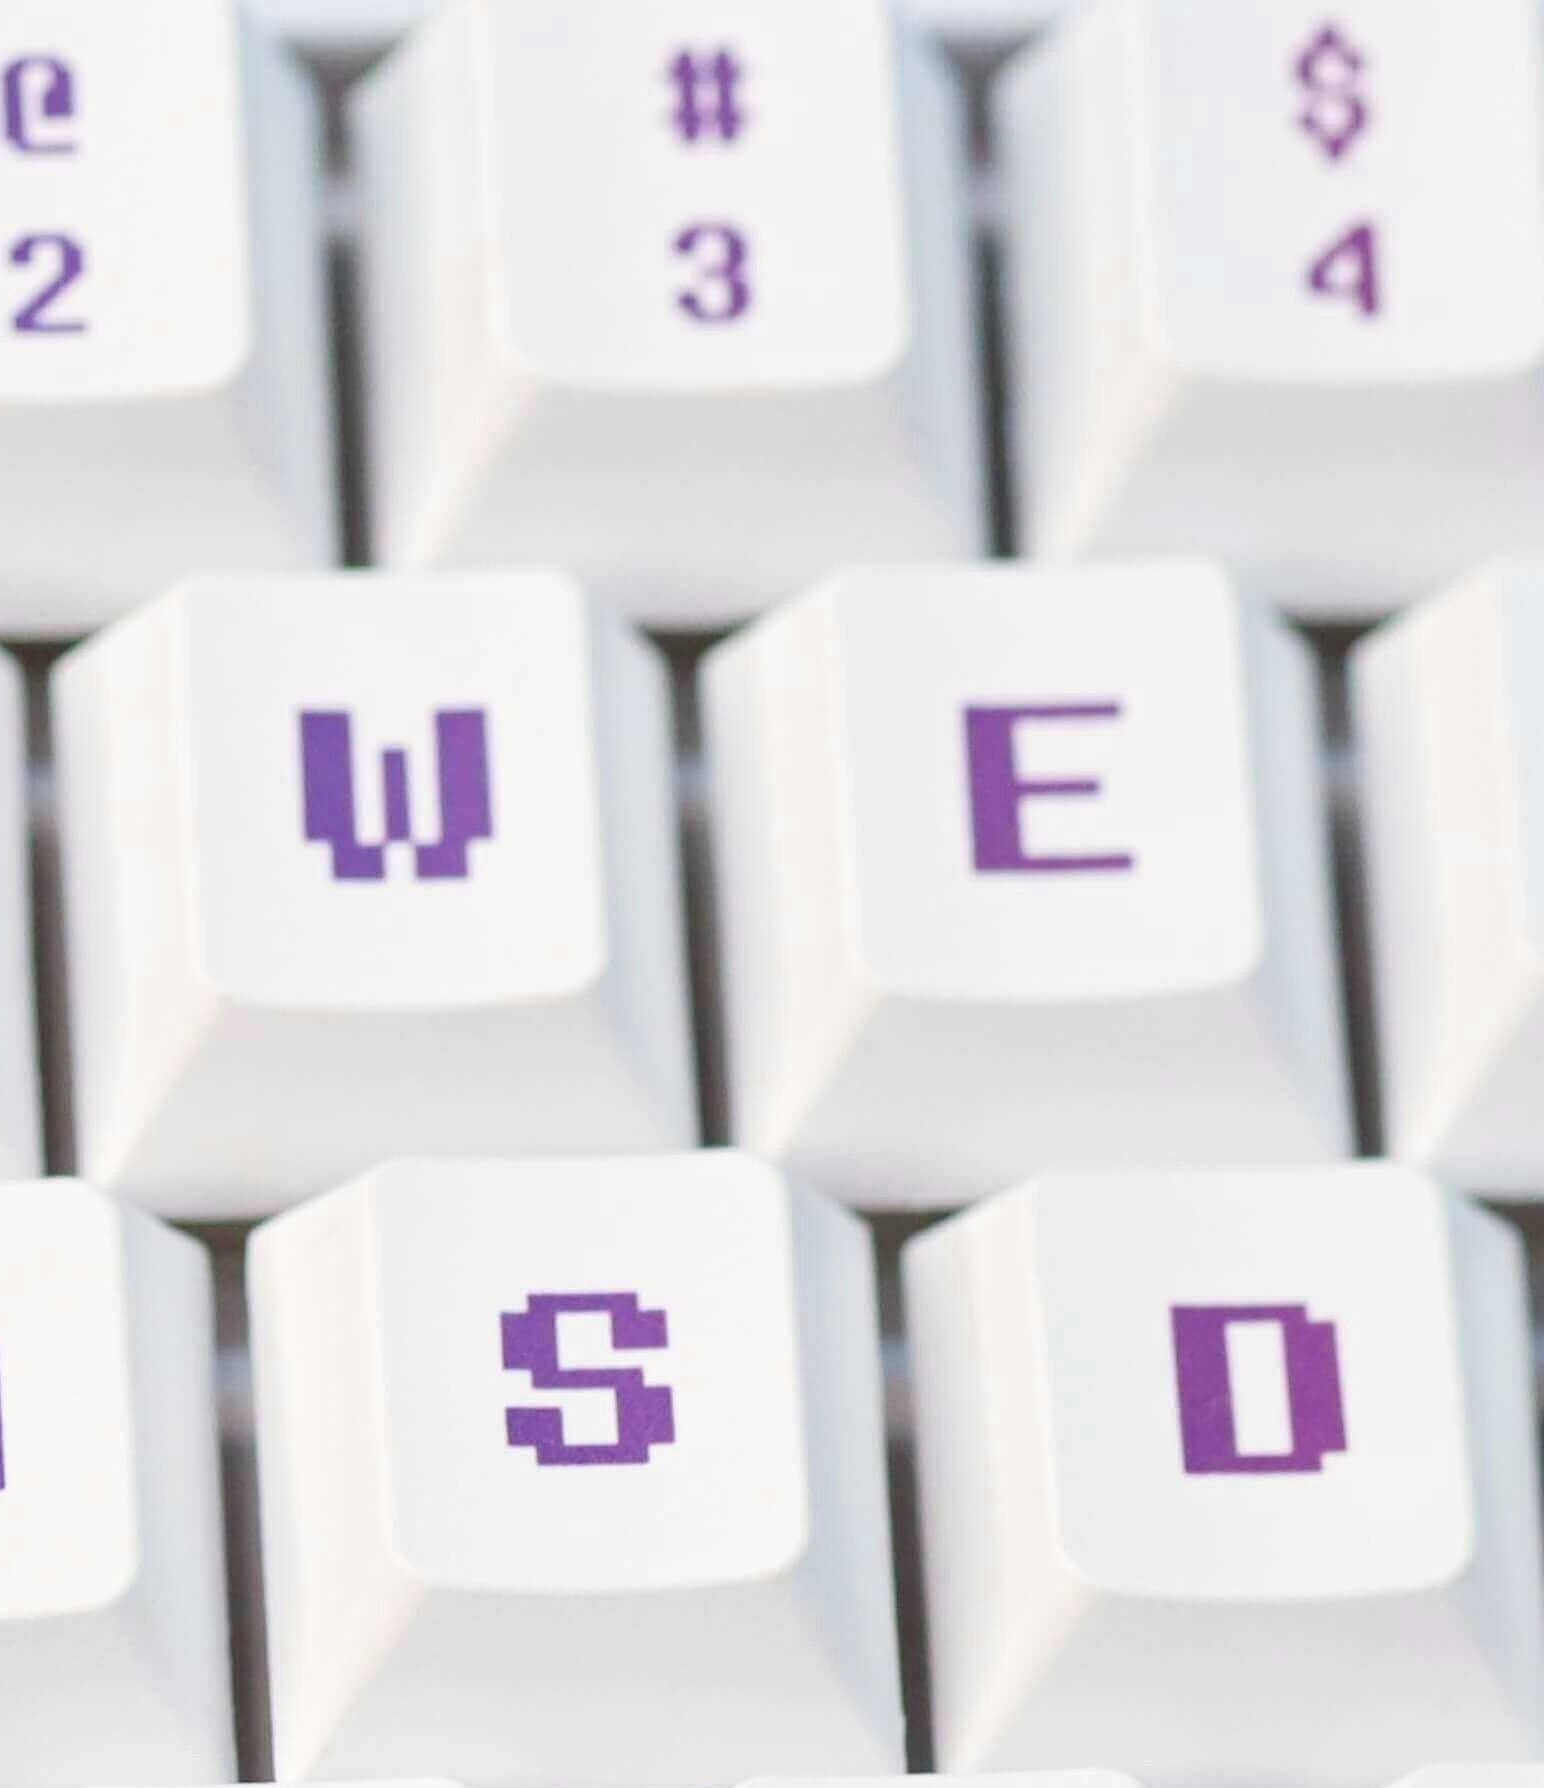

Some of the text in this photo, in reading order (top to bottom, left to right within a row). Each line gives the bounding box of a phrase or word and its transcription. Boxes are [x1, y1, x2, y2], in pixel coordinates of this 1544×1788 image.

[1, 58, 75, 153] @
[669, 50, 743, 143] #
[1294, 25, 1369, 162] $
[9, 235, 85, 334] 2
[674, 225, 751, 321] 3
[1307, 223, 1380, 316] 4
[300, 709, 491, 881] W
[964, 705, 1130, 871] E
[500, 1292, 674, 1465] S
[1171, 1305, 1345, 1474] D
